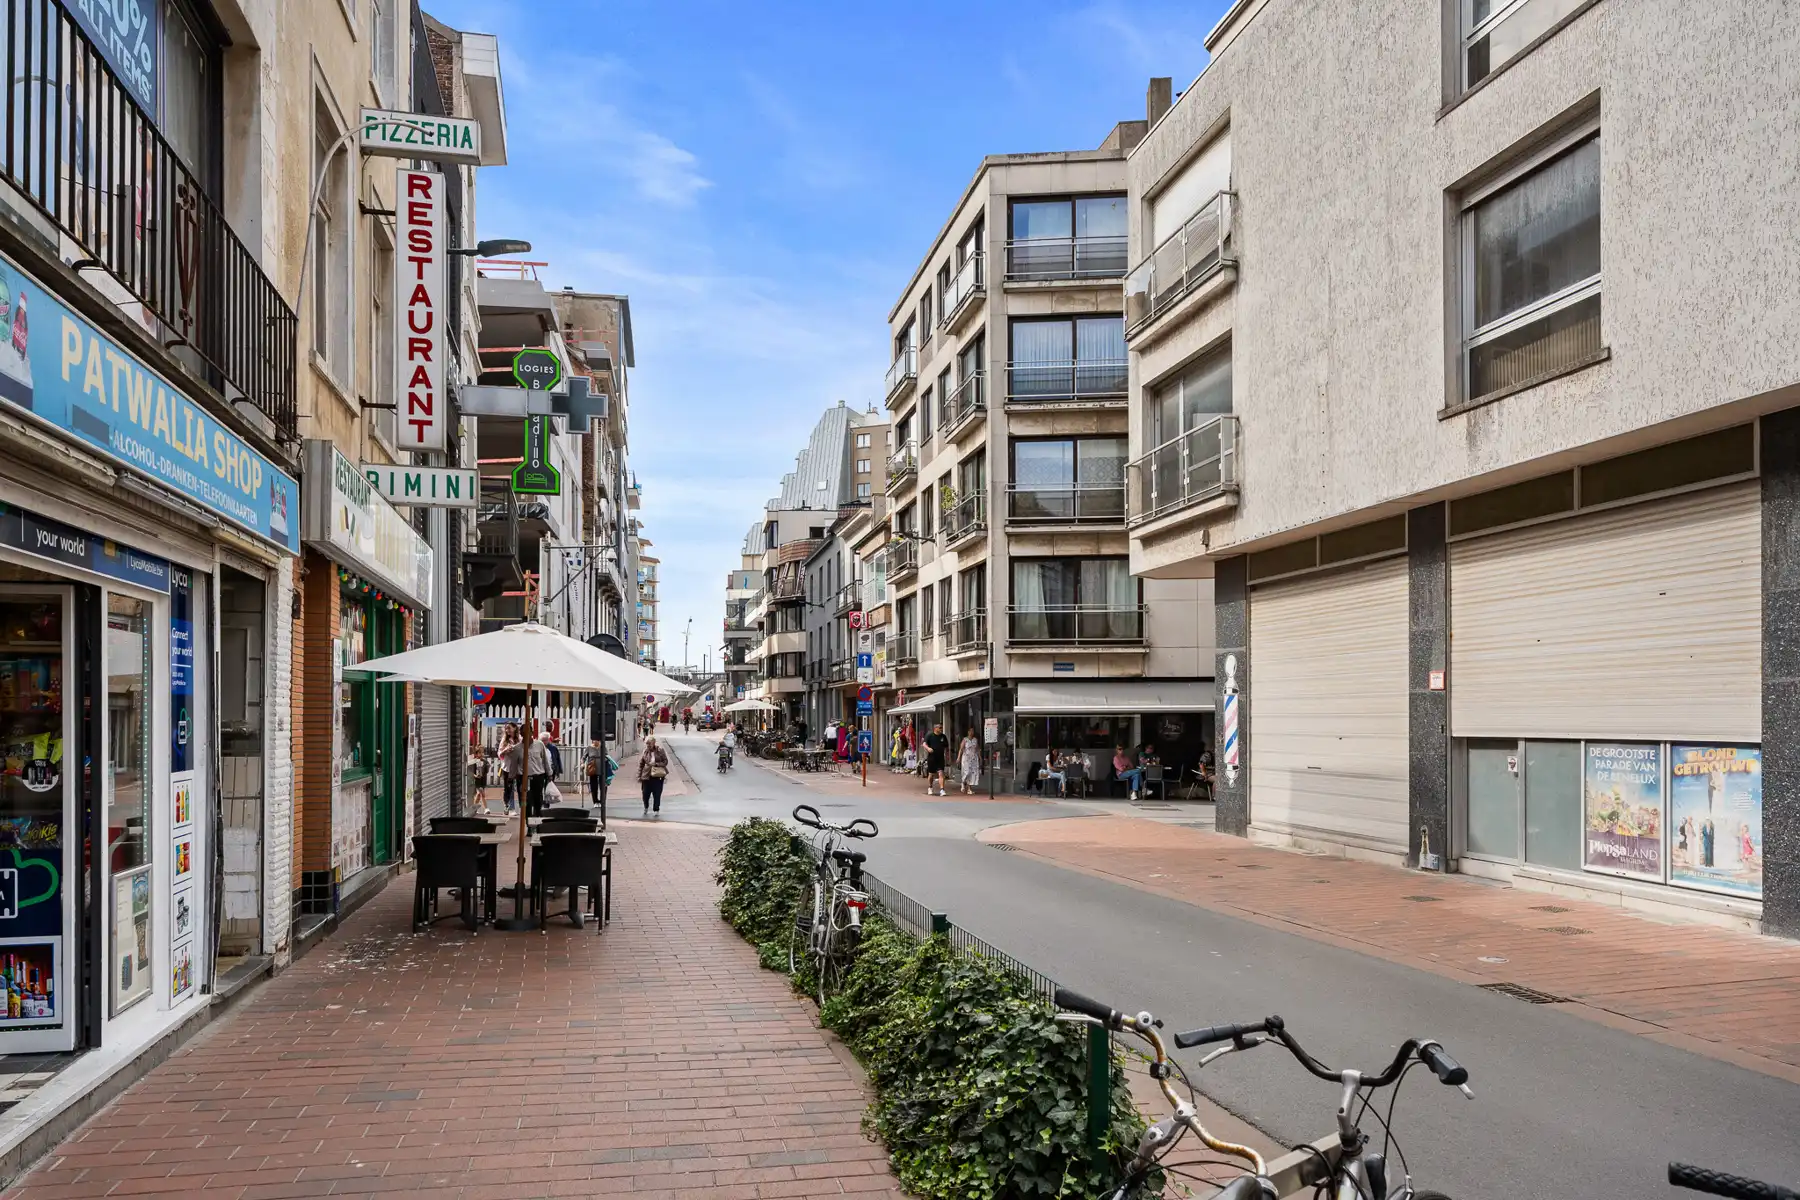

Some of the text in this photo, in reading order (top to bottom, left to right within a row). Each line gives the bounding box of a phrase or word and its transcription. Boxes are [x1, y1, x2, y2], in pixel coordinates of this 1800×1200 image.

[110, 27, 151, 103] ITEMS
[364, 116, 474, 150] PIZZERIA
[407, 173, 434, 444] RESTAURANT
[519, 364, 554, 374] LOGIES
[61, 314, 263, 500] PATWALIA SHOP
[335, 452, 372, 516] RESTAURANT
[36, 528, 85, 557] your world
[171, 566, 188, 588] Lyca
[1590, 747, 1656, 760] DE GROOTSTE
[1595, 759, 1656, 772] PARADE VAN
[1597, 770, 1609, 781] DE
